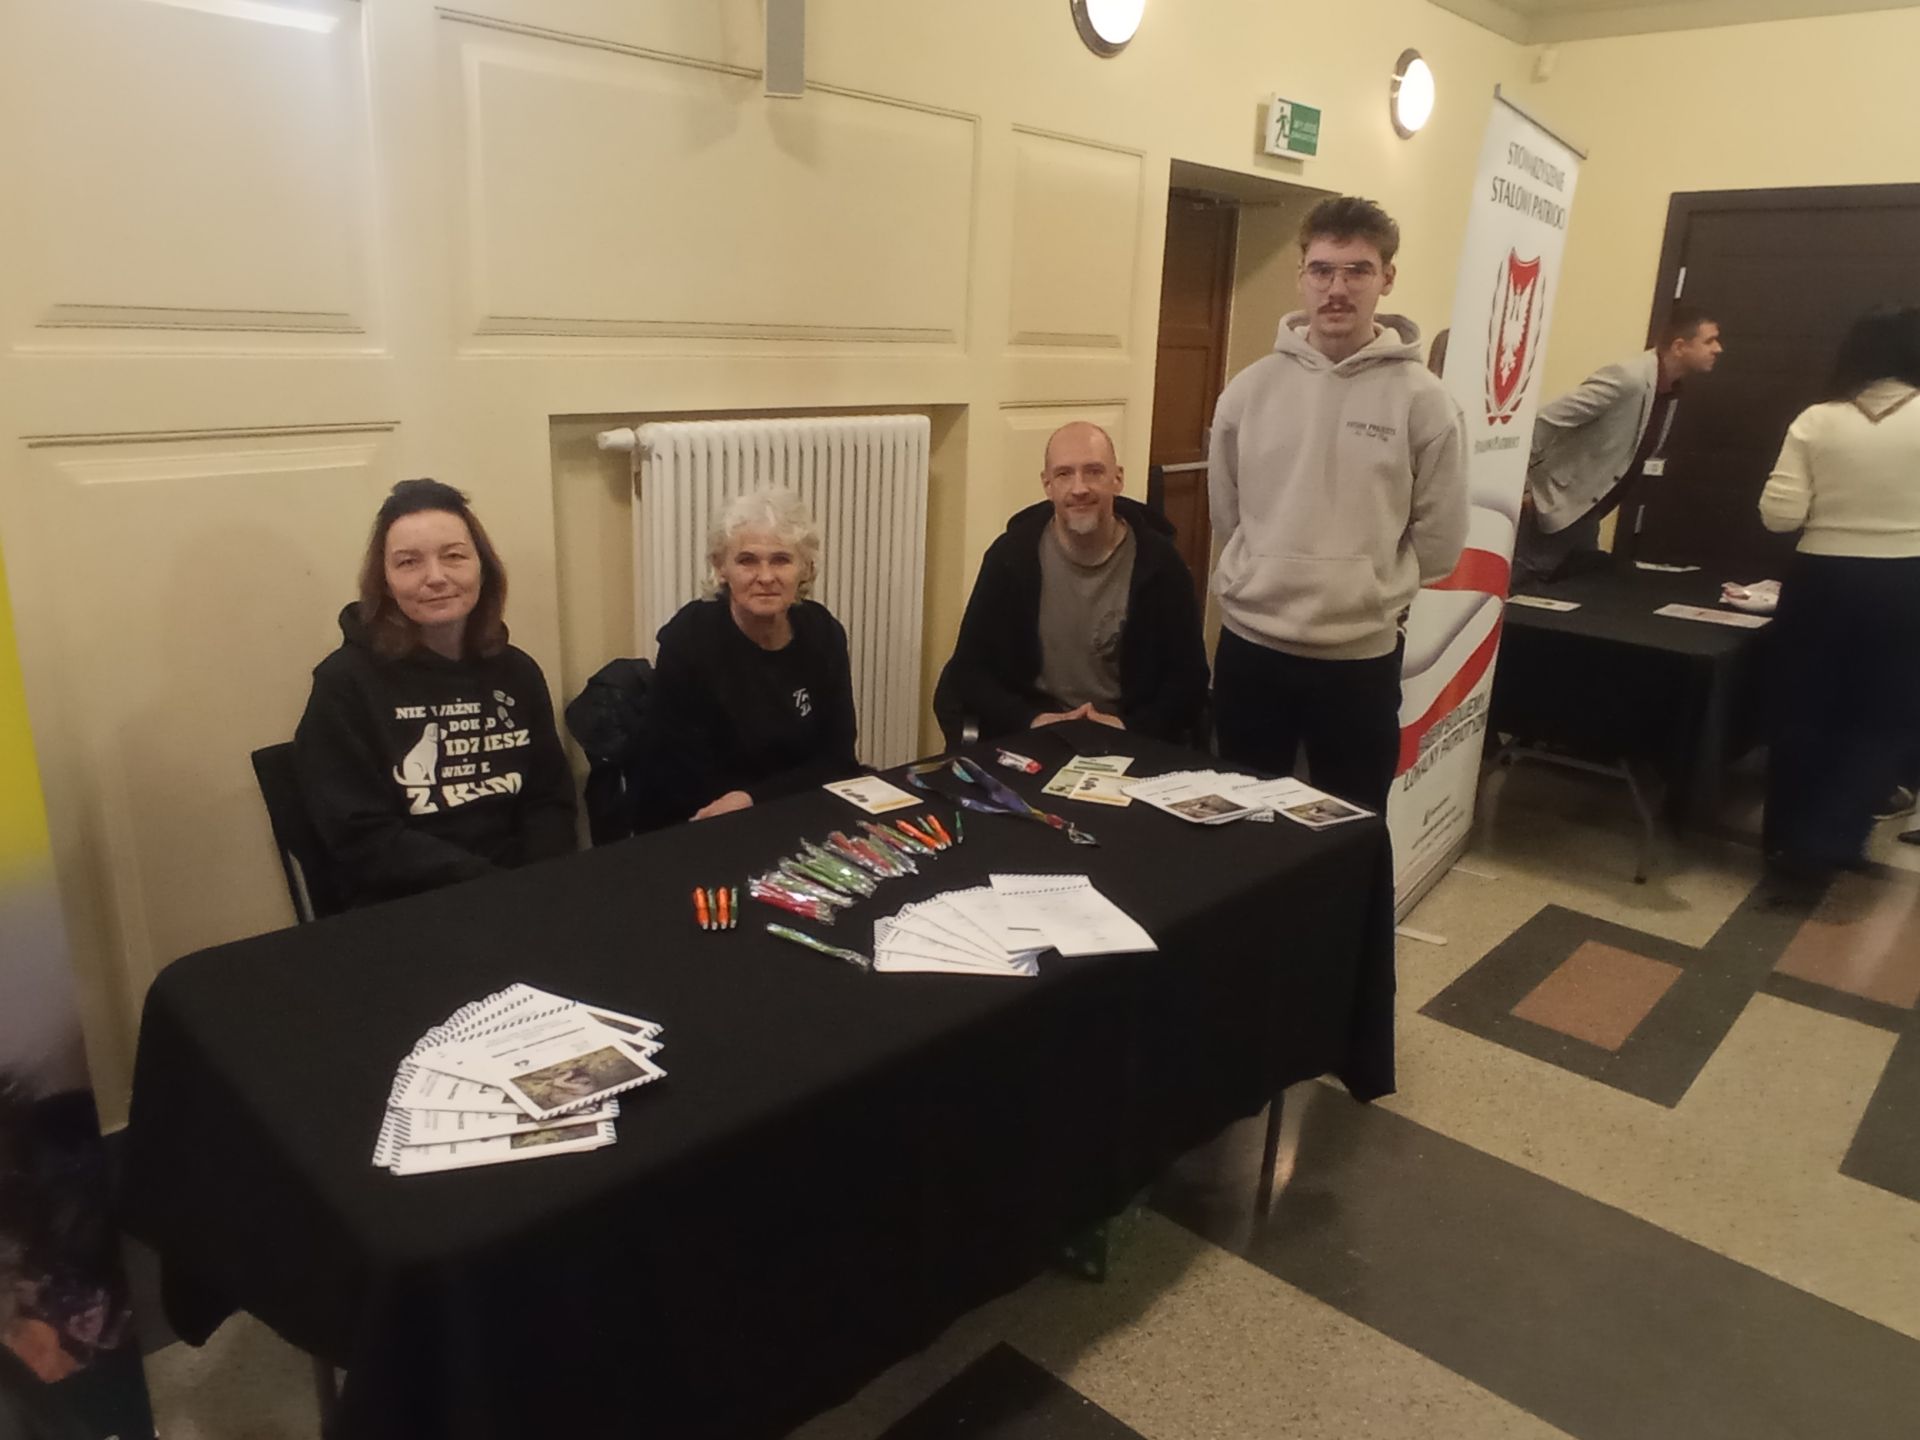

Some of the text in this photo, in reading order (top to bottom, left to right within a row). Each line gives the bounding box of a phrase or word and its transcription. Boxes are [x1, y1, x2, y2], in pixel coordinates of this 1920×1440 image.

[395, 706, 426, 719] NIE
[449, 717, 497, 732] DOKD
[406, 787, 439, 815] Z
